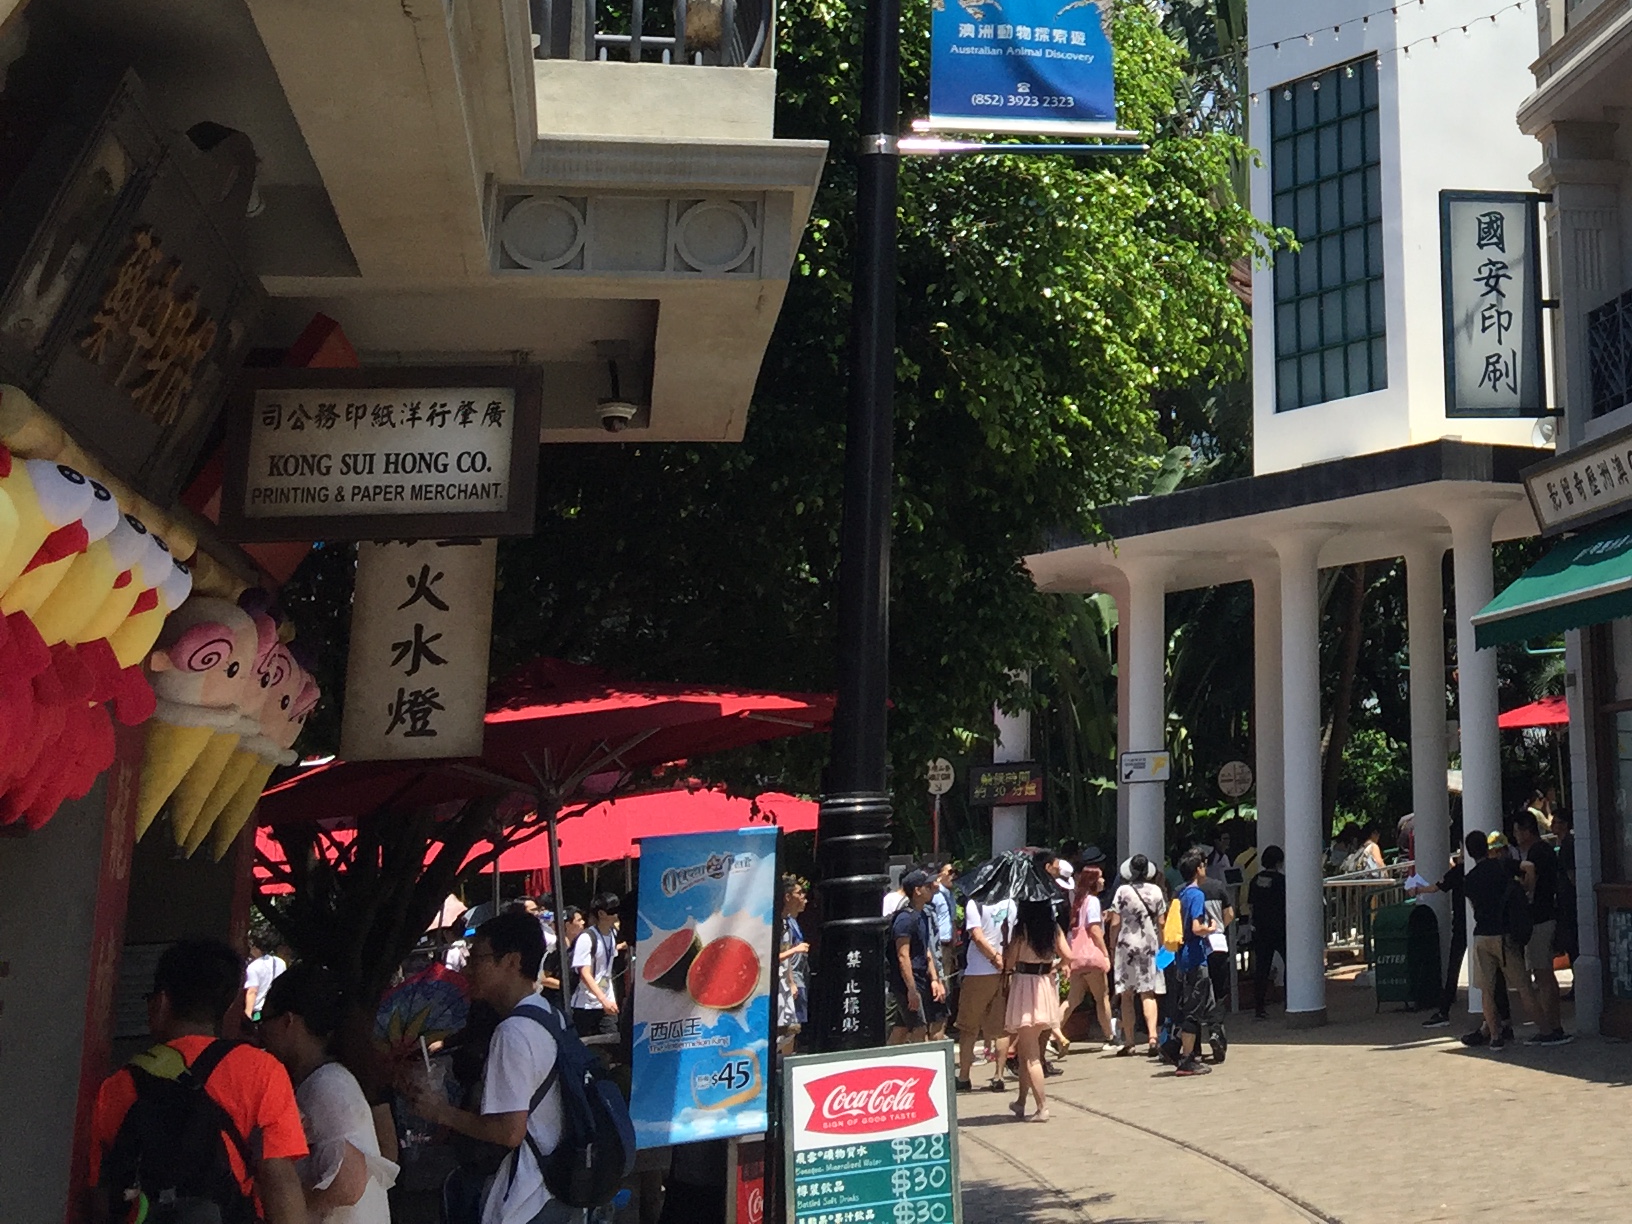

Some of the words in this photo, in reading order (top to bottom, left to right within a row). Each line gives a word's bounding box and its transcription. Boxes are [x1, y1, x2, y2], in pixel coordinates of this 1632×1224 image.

[950, 44, 1003, 56] Australian
[1006, 47, 1042, 58] Animal
[1045, 49, 1094, 64] Discovery
[971, 94, 1004, 107] (852)
[1007, 94, 1039, 107] 3923
[1043, 95, 1075, 108] 2323
[1473, 209, 1517, 394] 國安印刷
[268, 453, 332, 477] KONG
[340, 452, 376, 475] SUI
[383, 451, 449, 475] HONG
[456, 450, 492, 474] CO.
[252, 486, 329, 505] PRINTING
[334, 486, 346, 503] &
[351, 484, 405, 503] PAPER
[1377, 954, 1406, 965] LITTER
[650, 1017, 702, 1042] 西瓜王
[711, 1060, 750, 1090] $45
[823, 1120, 844, 1130] SIGN
[847, 1117, 858, 1126] OF
[862, 1115, 887, 1125] GOOD
[890, 1111, 917, 1121] TASTE
[891, 1133, 945, 1164] $28
[892, 1166, 947, 1199] $30
[893, 1200, 947, 1224] $30
